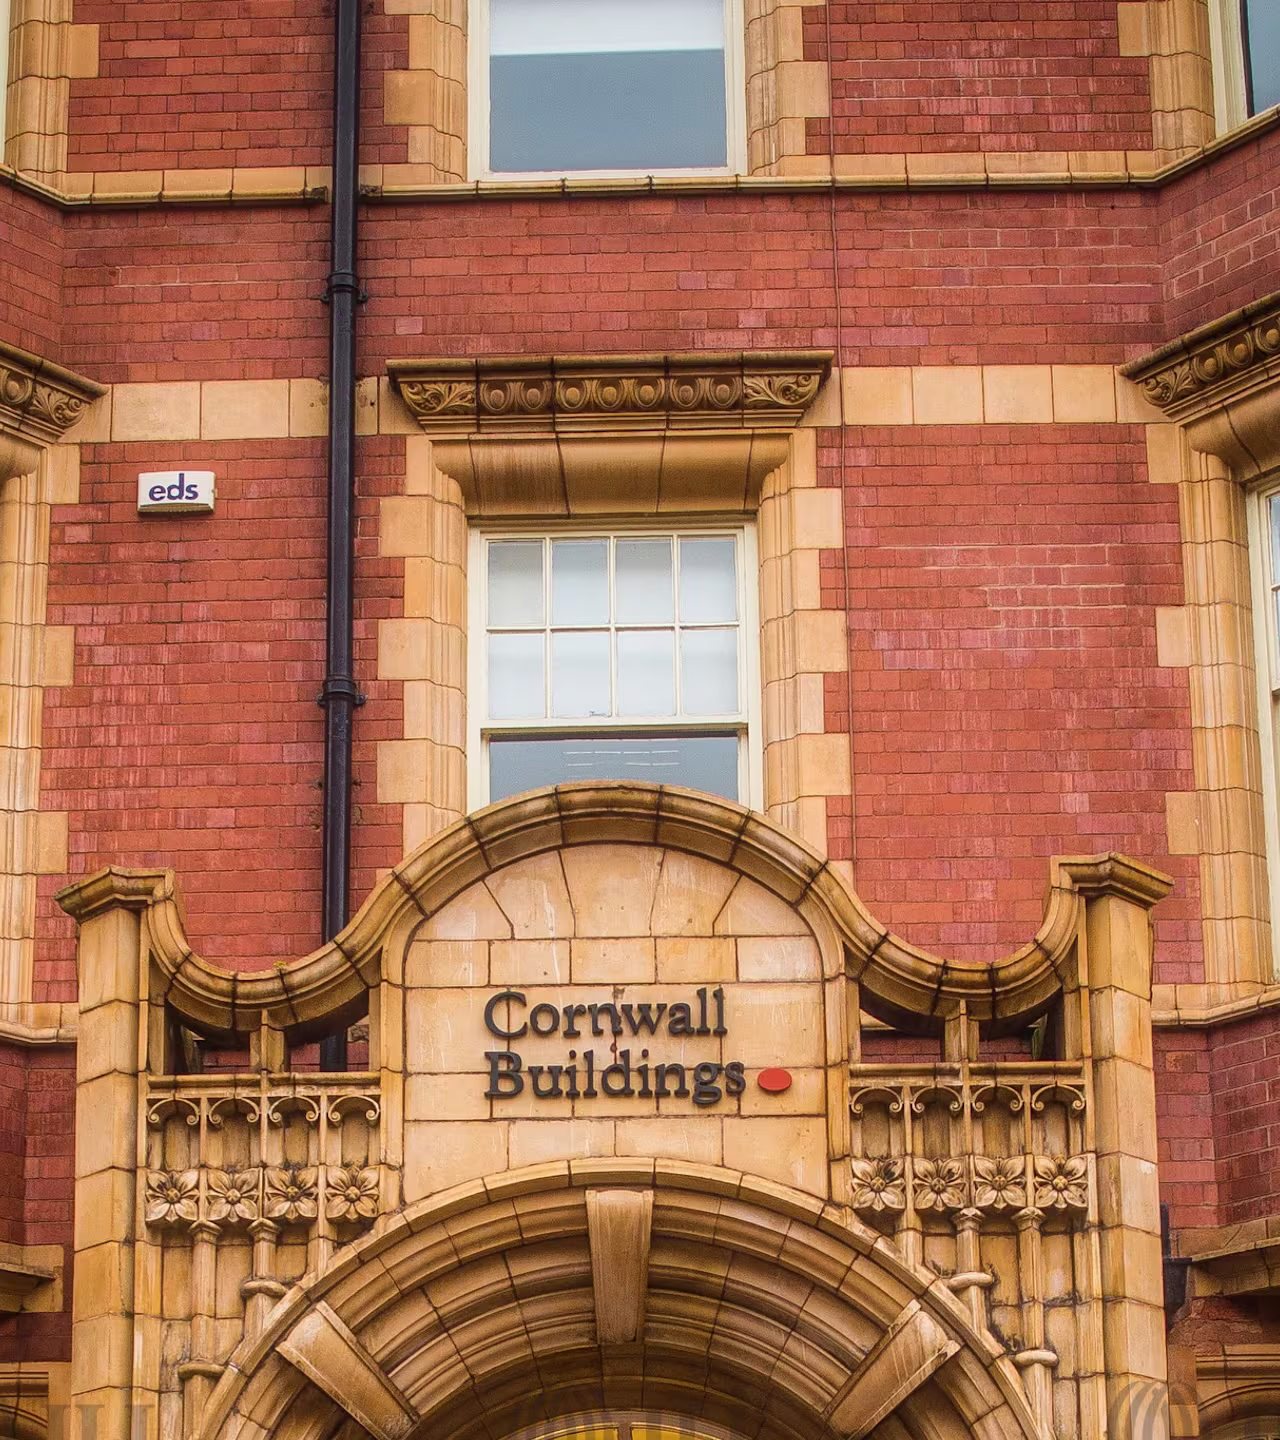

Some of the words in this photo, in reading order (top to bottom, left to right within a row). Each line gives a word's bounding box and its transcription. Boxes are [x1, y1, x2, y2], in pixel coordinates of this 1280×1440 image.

[148, 472, 199, 502] eds
[483, 987, 728, 1040] Cornwall
[483, 1048, 747, 1105] Buildings
